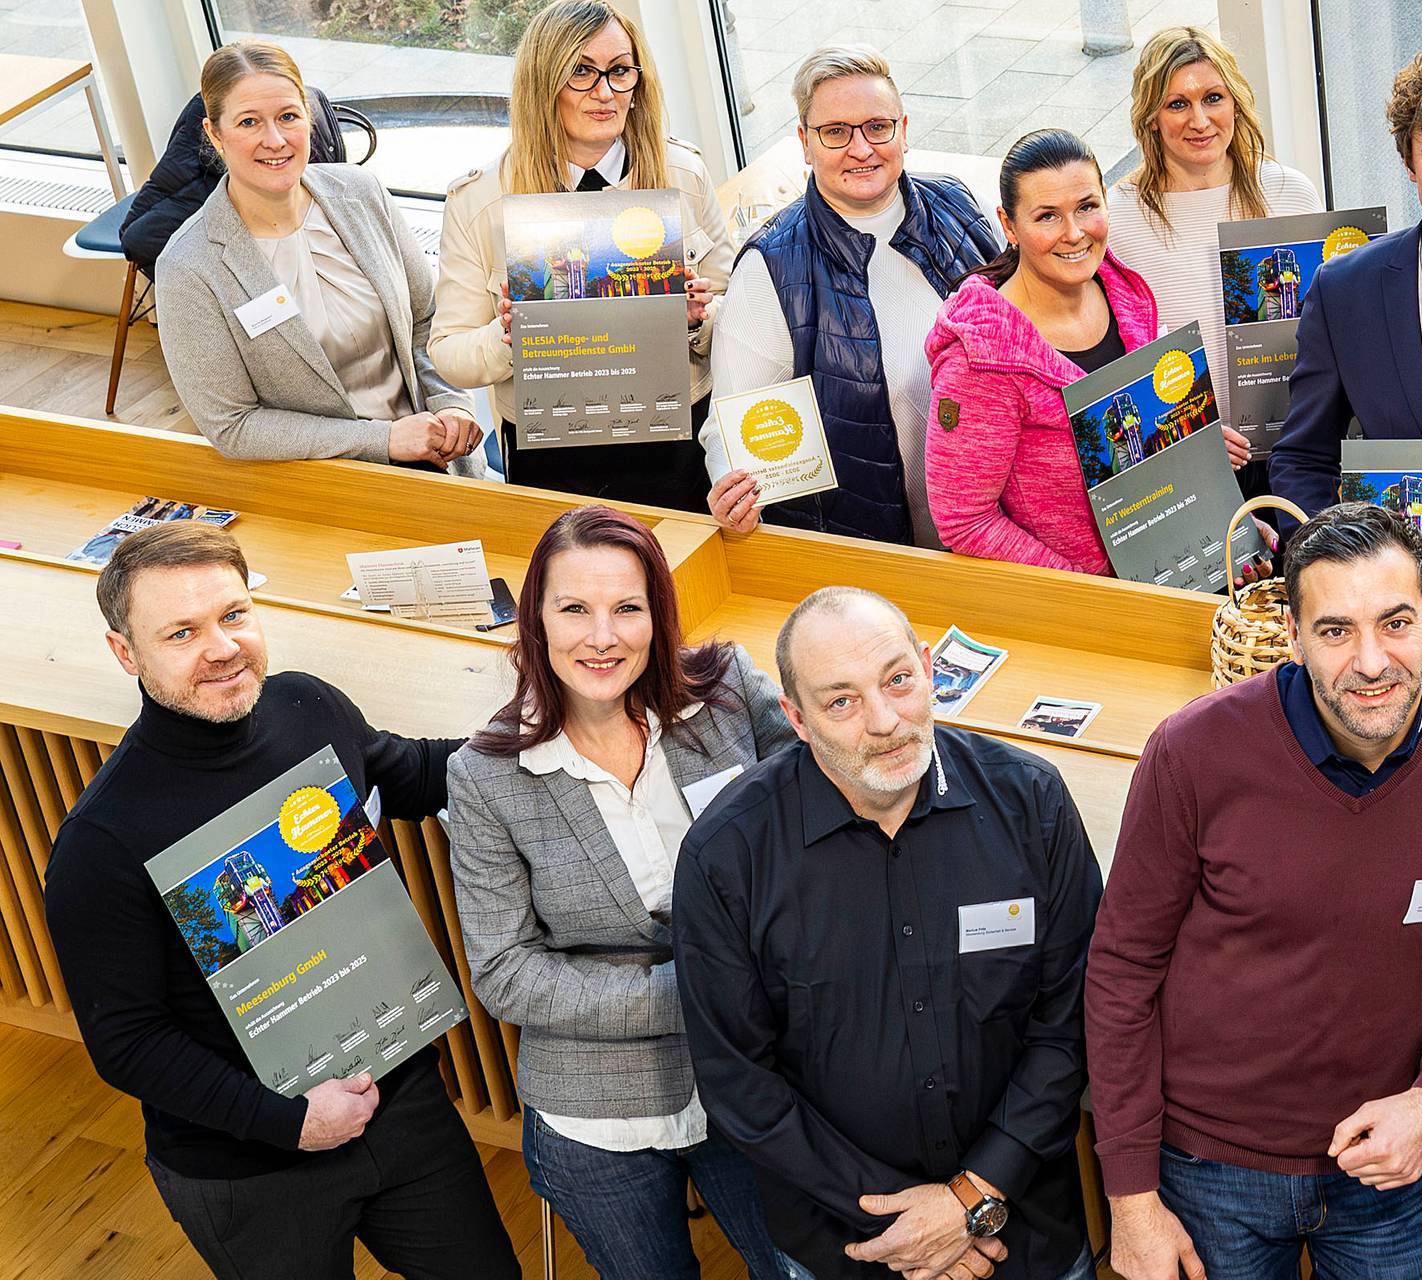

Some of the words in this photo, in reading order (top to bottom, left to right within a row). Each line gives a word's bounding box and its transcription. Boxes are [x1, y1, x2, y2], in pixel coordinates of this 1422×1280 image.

[521, 336, 556, 346] SILESIA
[557, 334, 589, 346] Pflege-
[591, 332, 609, 342] und
[522, 346, 606, 359] Betreuungsdienste
[608, 344, 636, 354] GmbH
[1236, 356, 1260, 367] Stark
[1262, 354, 1272, 364] im
[523, 372, 543, 381] Echter
[544, 371, 570, 379] Hammer
[570, 370, 593, 378] Betrieb
[594, 368, 610, 377] 2023
[610, 368, 620, 376] bis
[620, 367, 637, 375] 2025
[1237, 379, 1256, 387] Echter
[1257, 377, 1281, 385] Hammer
[1105, 512, 1119, 527] AvT
[1119, 483, 1174, 519] Westerntraining
[1112, 534, 1128, 547] Echter
[1128, 523, 1148, 539] Hammer
[1147, 512, 1166, 527] Betrieb
[1165, 505, 1178, 517] 2023
[1177, 501, 1185, 510] bis
[1184, 494, 1197, 506] 2025
[235, 972, 297, 1017] Meesenburg
[296, 949, 327, 975] GmbH
[248, 1022, 271, 1039] Echter
[270, 1002, 299, 1024] Hammer
[297, 985, 323, 1005] Betrieb
[322, 973, 340, 989] 2023
[339, 966, 350, 979] bis
[349, 954, 367, 970] 2025
